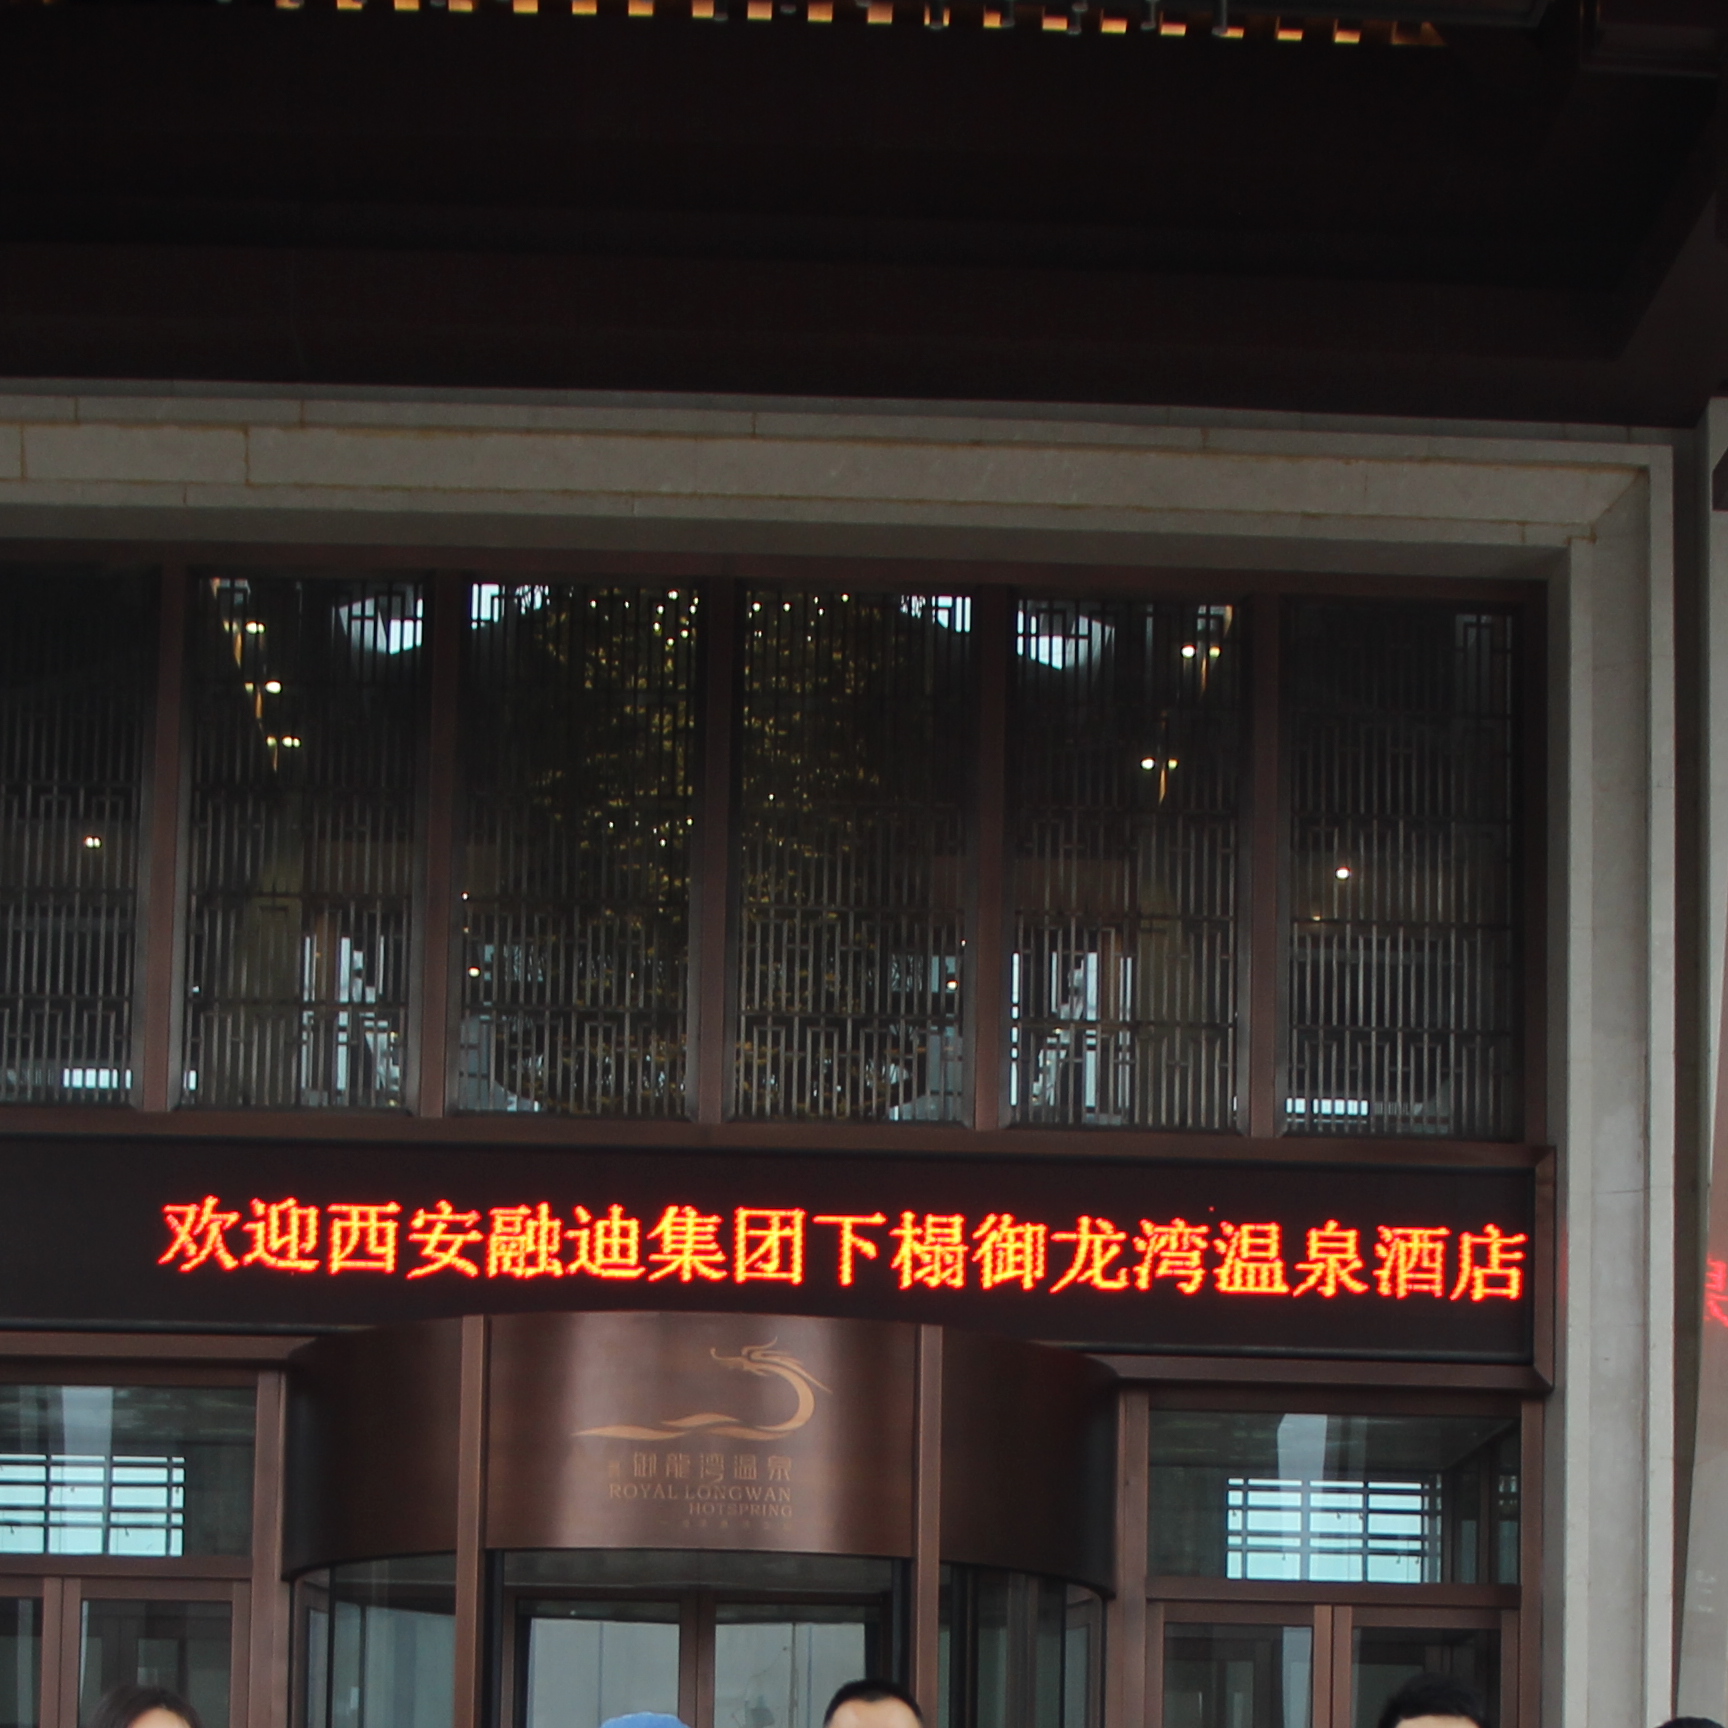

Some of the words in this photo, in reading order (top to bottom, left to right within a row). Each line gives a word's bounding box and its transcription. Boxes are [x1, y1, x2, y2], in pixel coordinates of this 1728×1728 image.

[158, 1194, 1527, 1302] 欢迎西安融迪集团下榻御龙湾温泉酒店
[609, 1483, 678, 1500] ROYAL
[685, 1485, 791, 1503] LONGWAN
[689, 1502, 792, 1518] HOTSPRING
